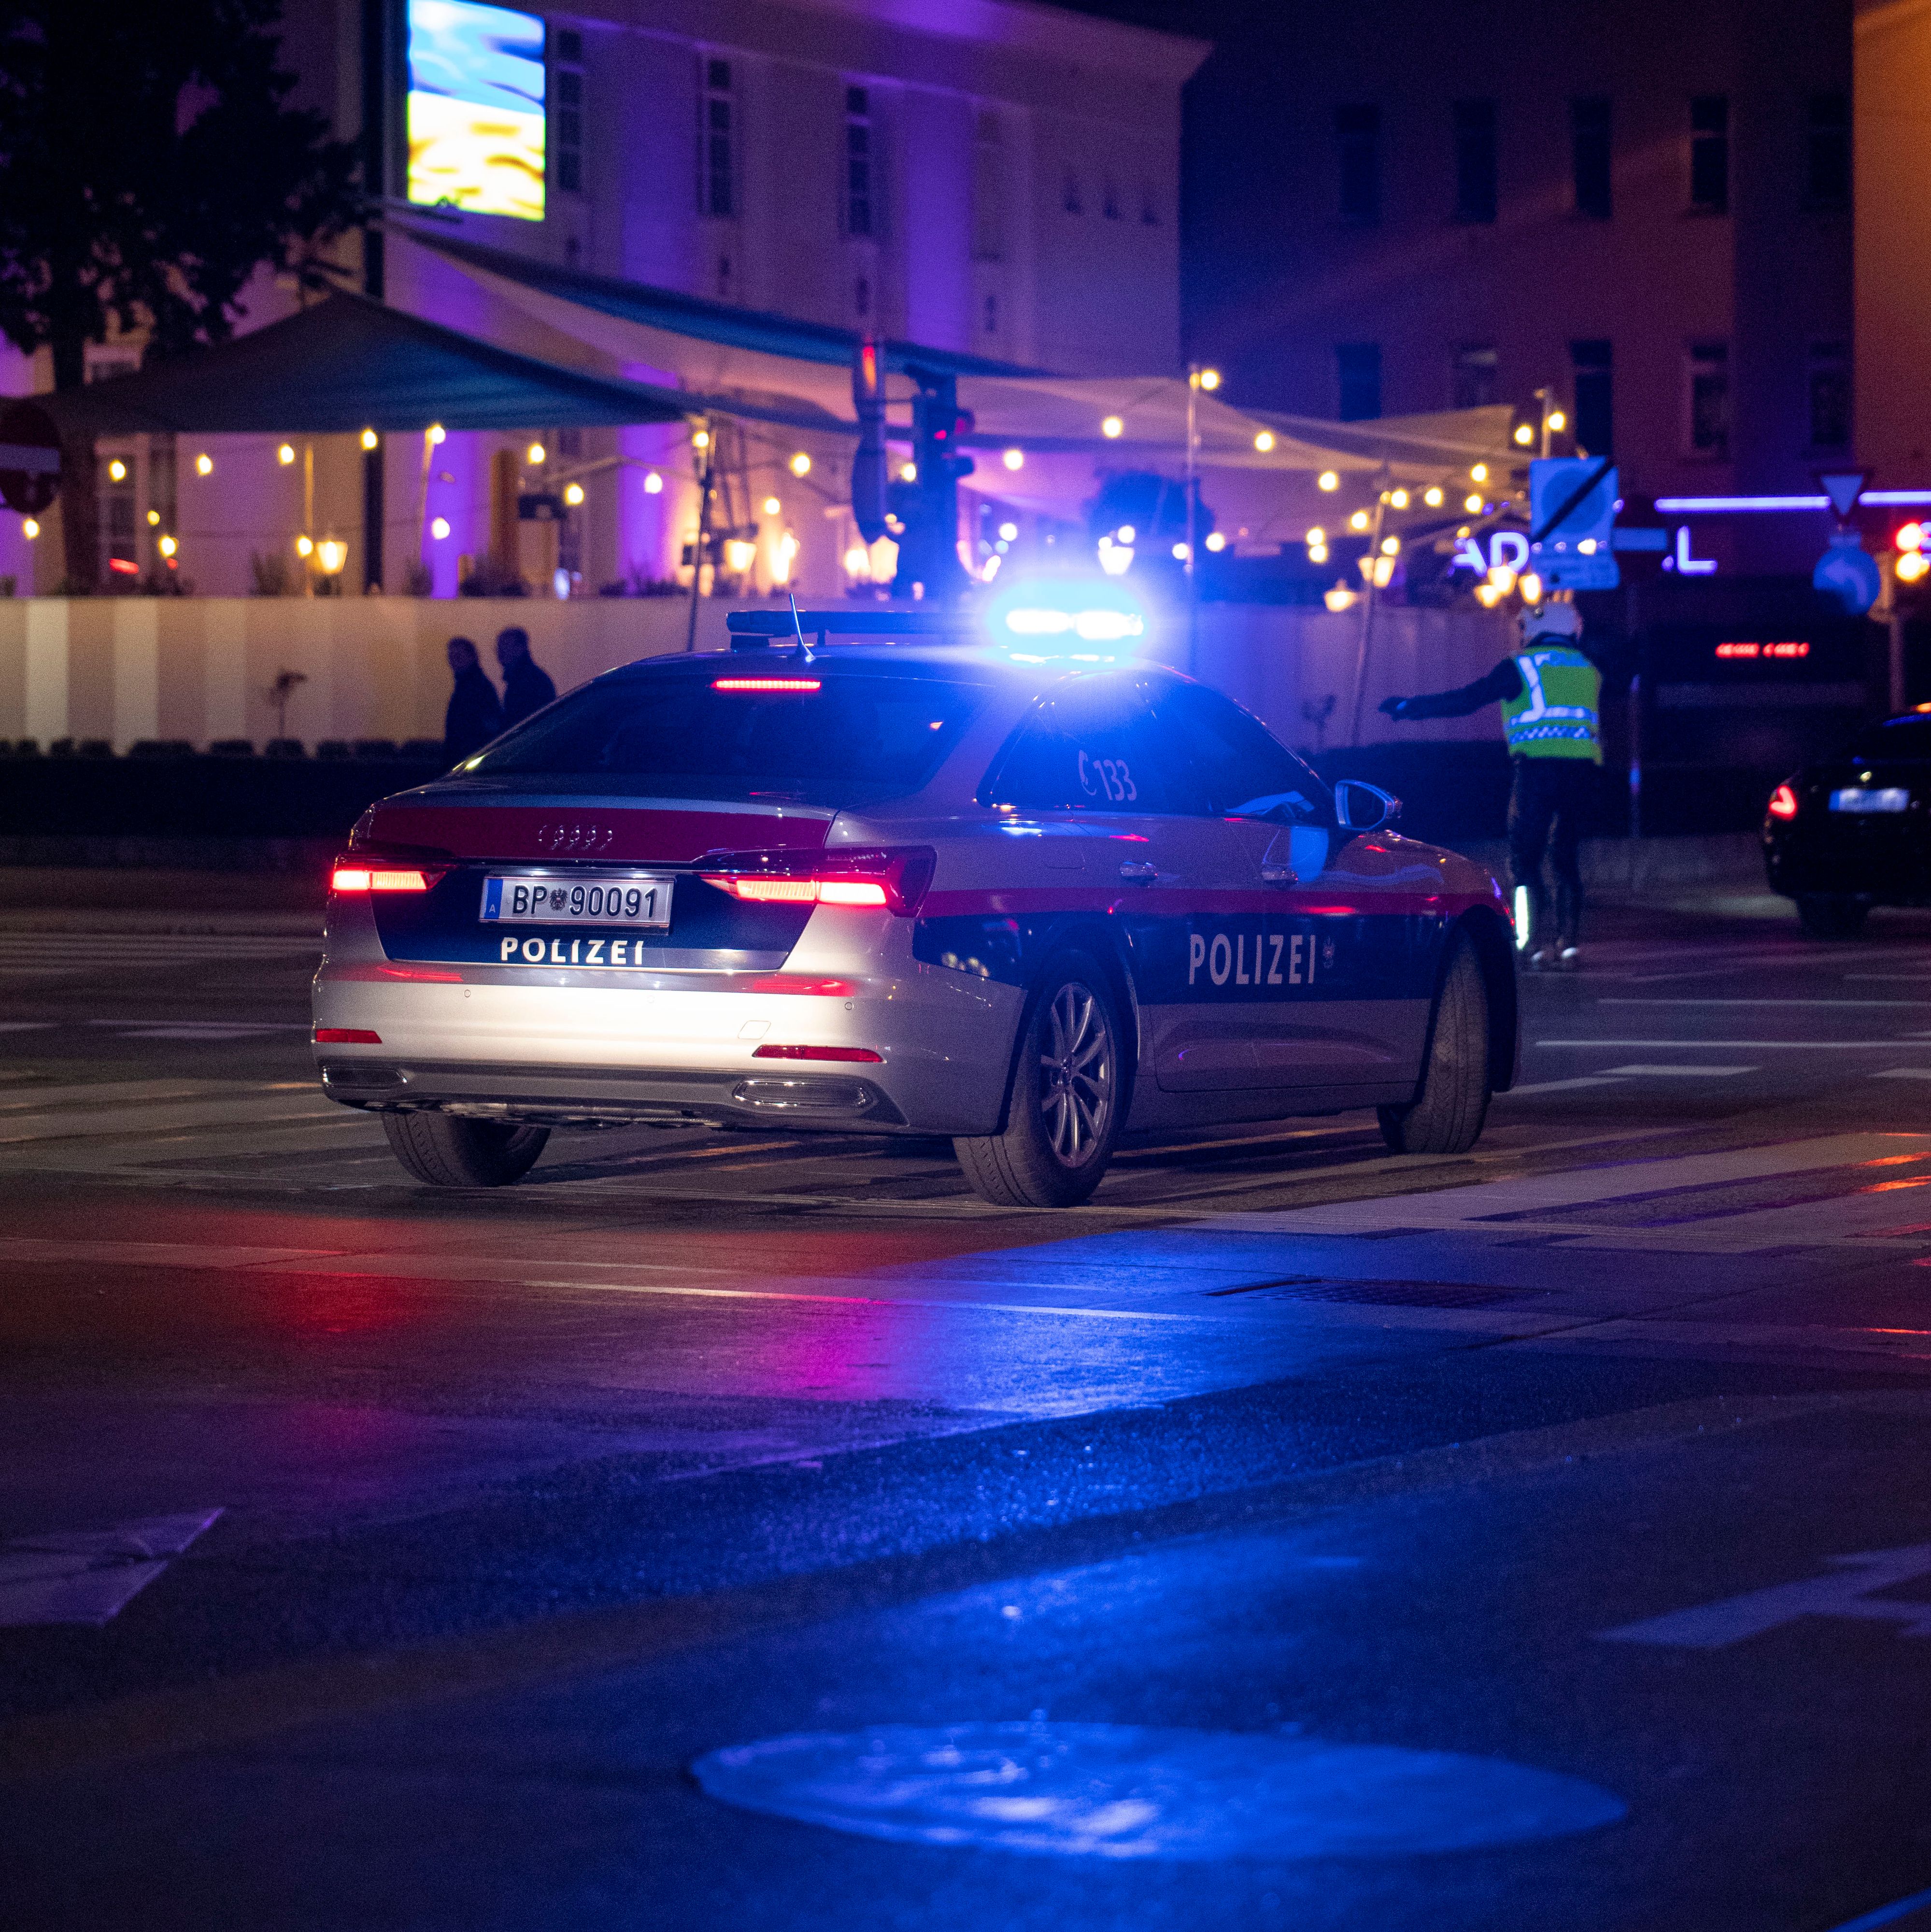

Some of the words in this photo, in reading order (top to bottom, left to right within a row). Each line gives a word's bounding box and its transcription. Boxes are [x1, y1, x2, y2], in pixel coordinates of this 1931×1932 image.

[1093, 759, 1137, 801] 133
[489, 903, 496, 913] A
[513, 885, 547, 914] BP
[569, 885, 656, 918] 90091
[501, 938, 643, 965] POLIZEI
[1189, 934, 1316, 985] POLIZEI
